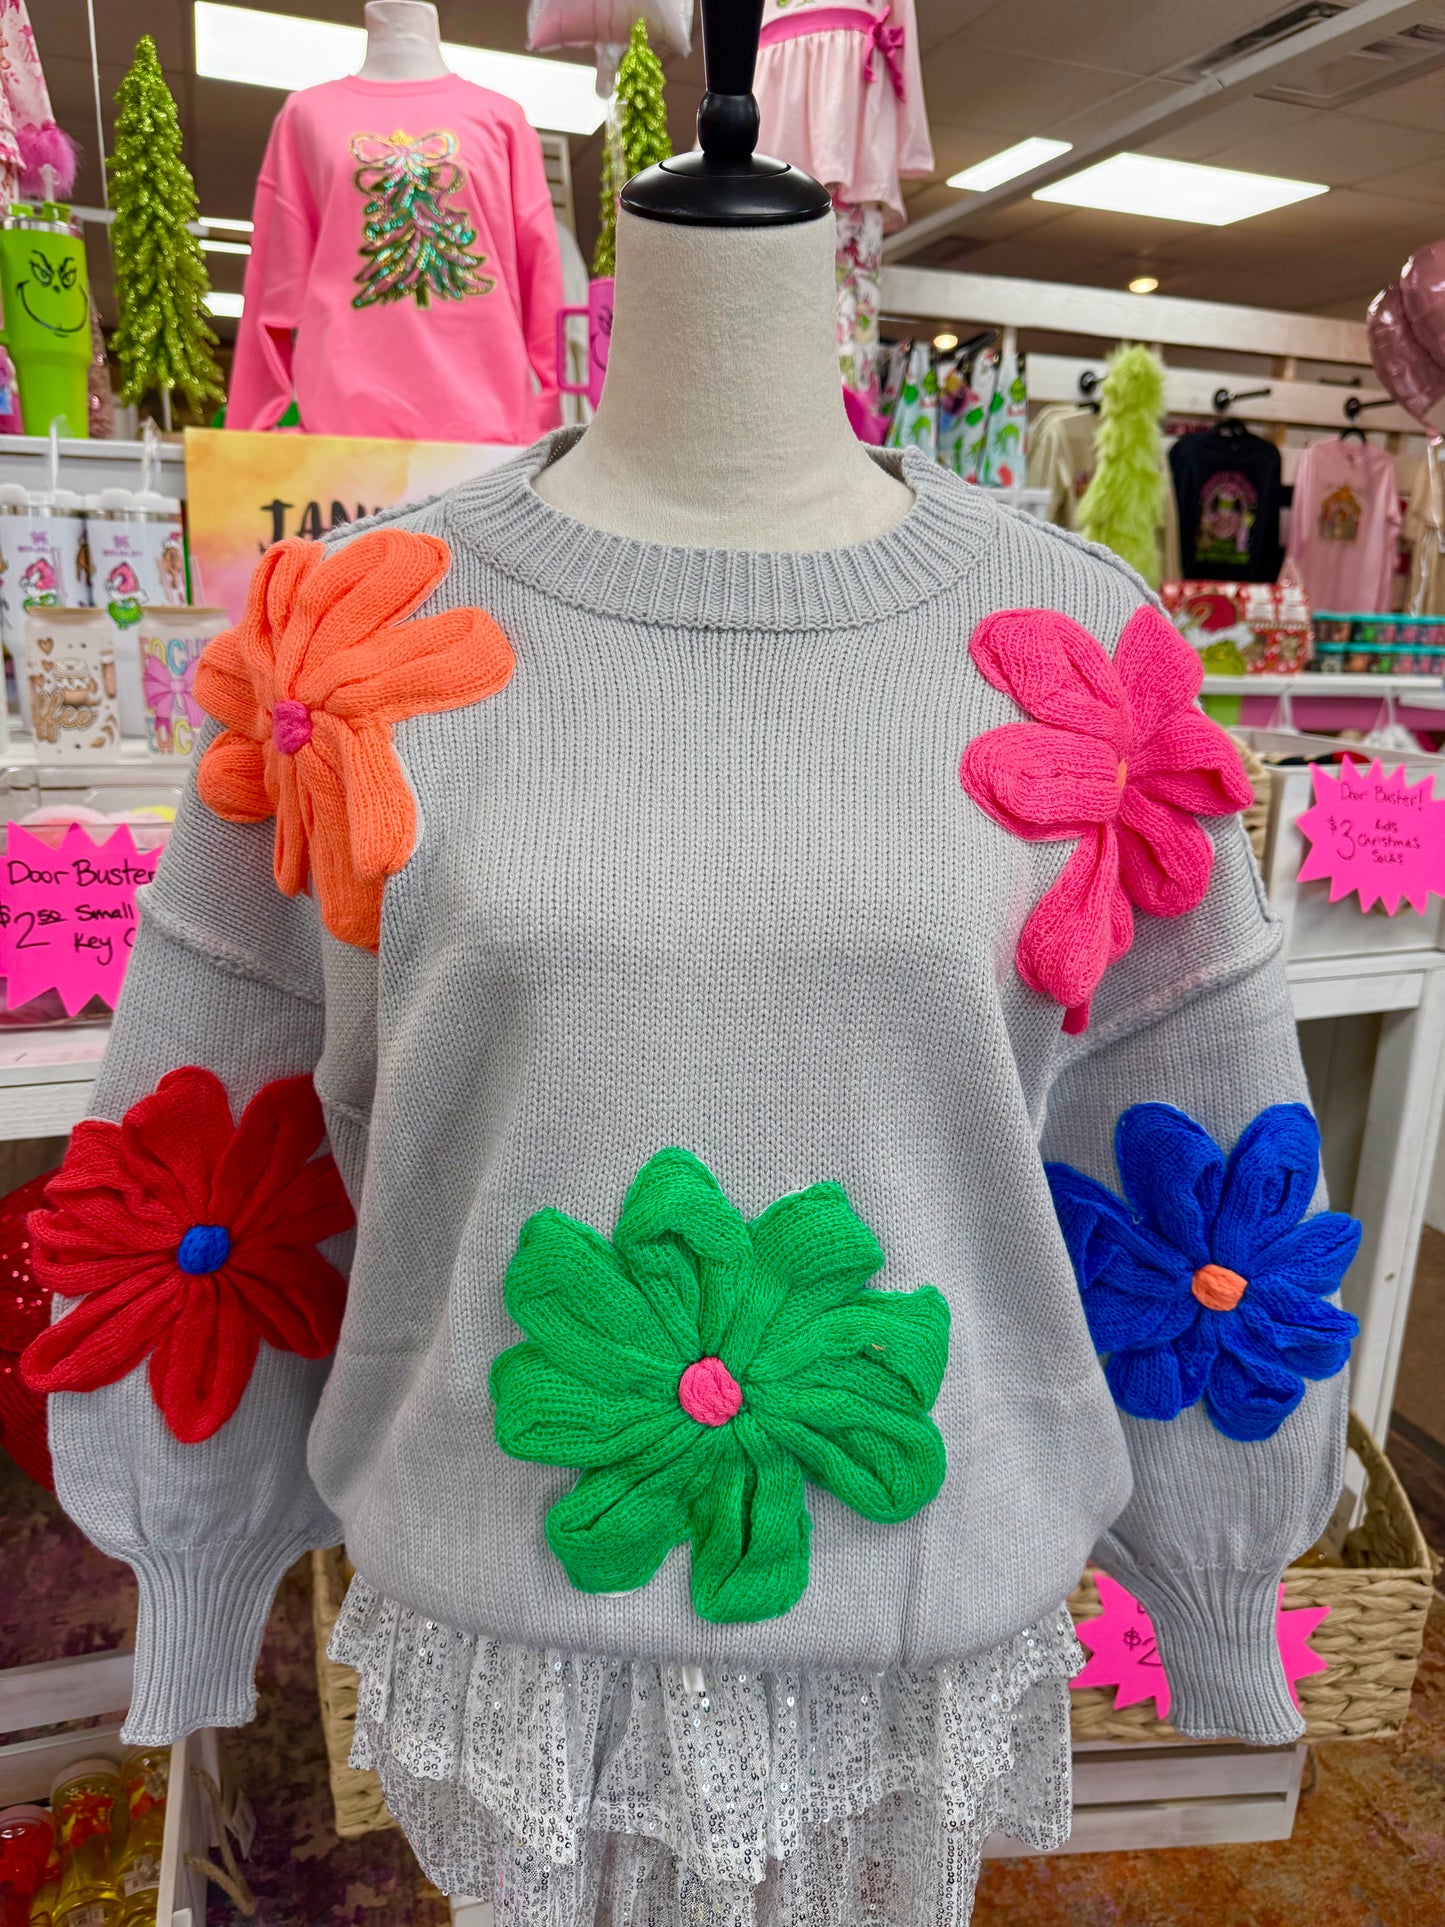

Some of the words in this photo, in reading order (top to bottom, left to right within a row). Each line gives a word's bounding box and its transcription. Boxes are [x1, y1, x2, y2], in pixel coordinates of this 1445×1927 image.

[1340, 782, 1369, 801] Door
[1374, 785, 1424, 812] Buster!
[1327, 815, 1356, 861] $3
[1357, 833, 1421, 850] Christmas
[1371, 849, 1404, 866] Socks
[7, 860, 70, 885] Door
[74, 901, 135, 922] Small
[73, 931, 114, 967] Key
